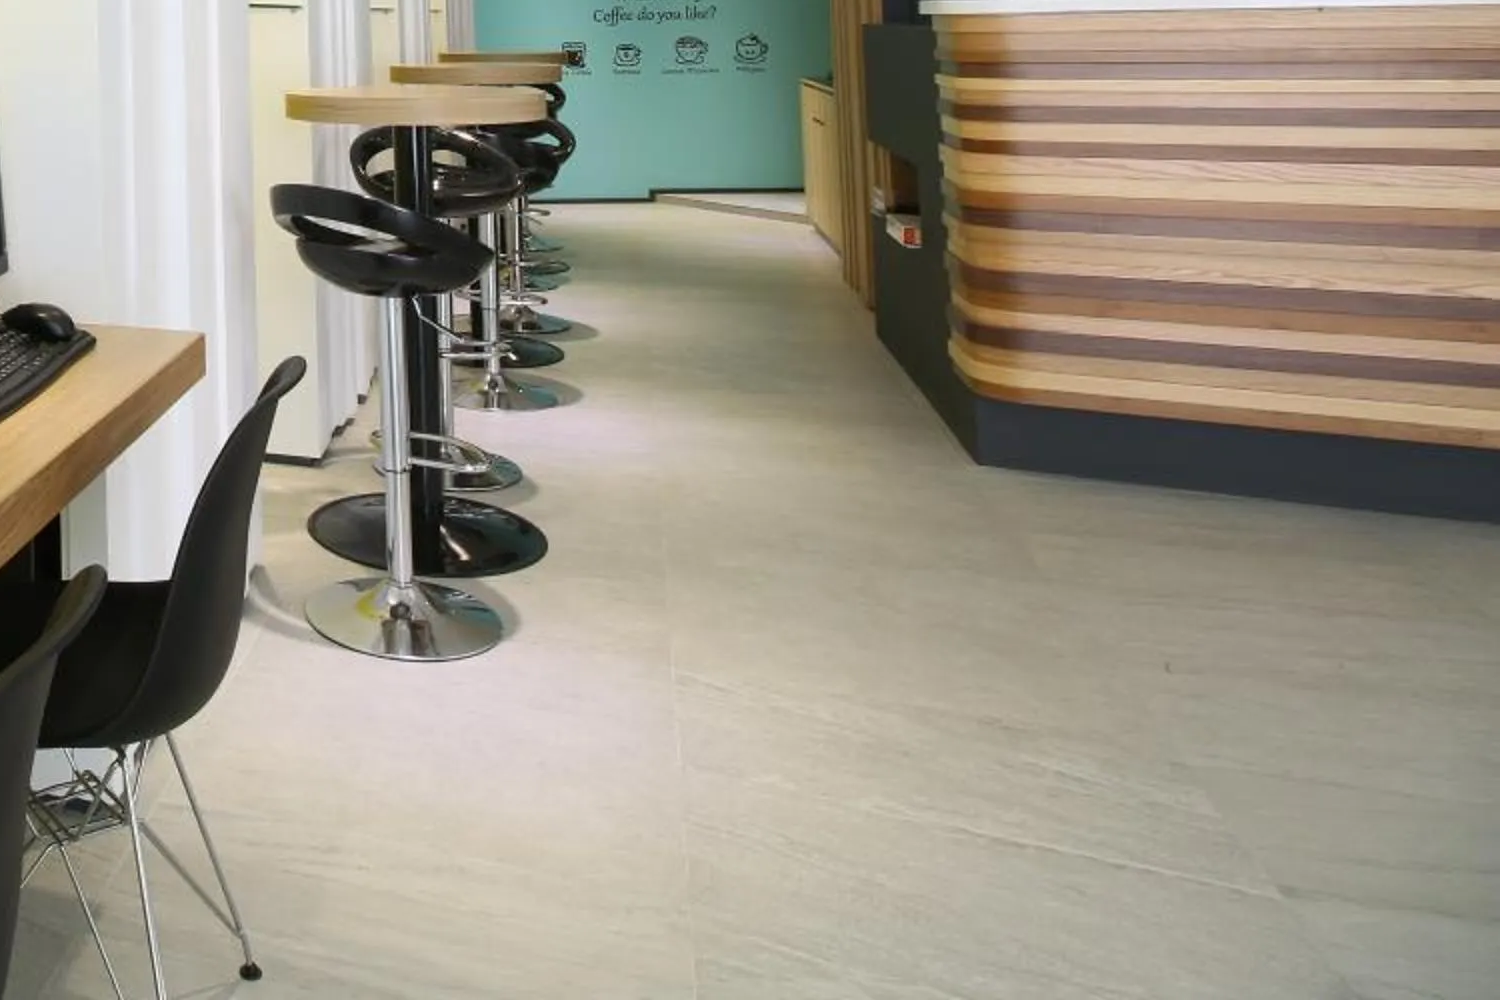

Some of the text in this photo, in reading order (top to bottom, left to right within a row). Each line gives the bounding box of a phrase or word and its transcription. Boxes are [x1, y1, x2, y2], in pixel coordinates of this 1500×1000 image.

[593, 5, 717, 27] Coffee do you like?
